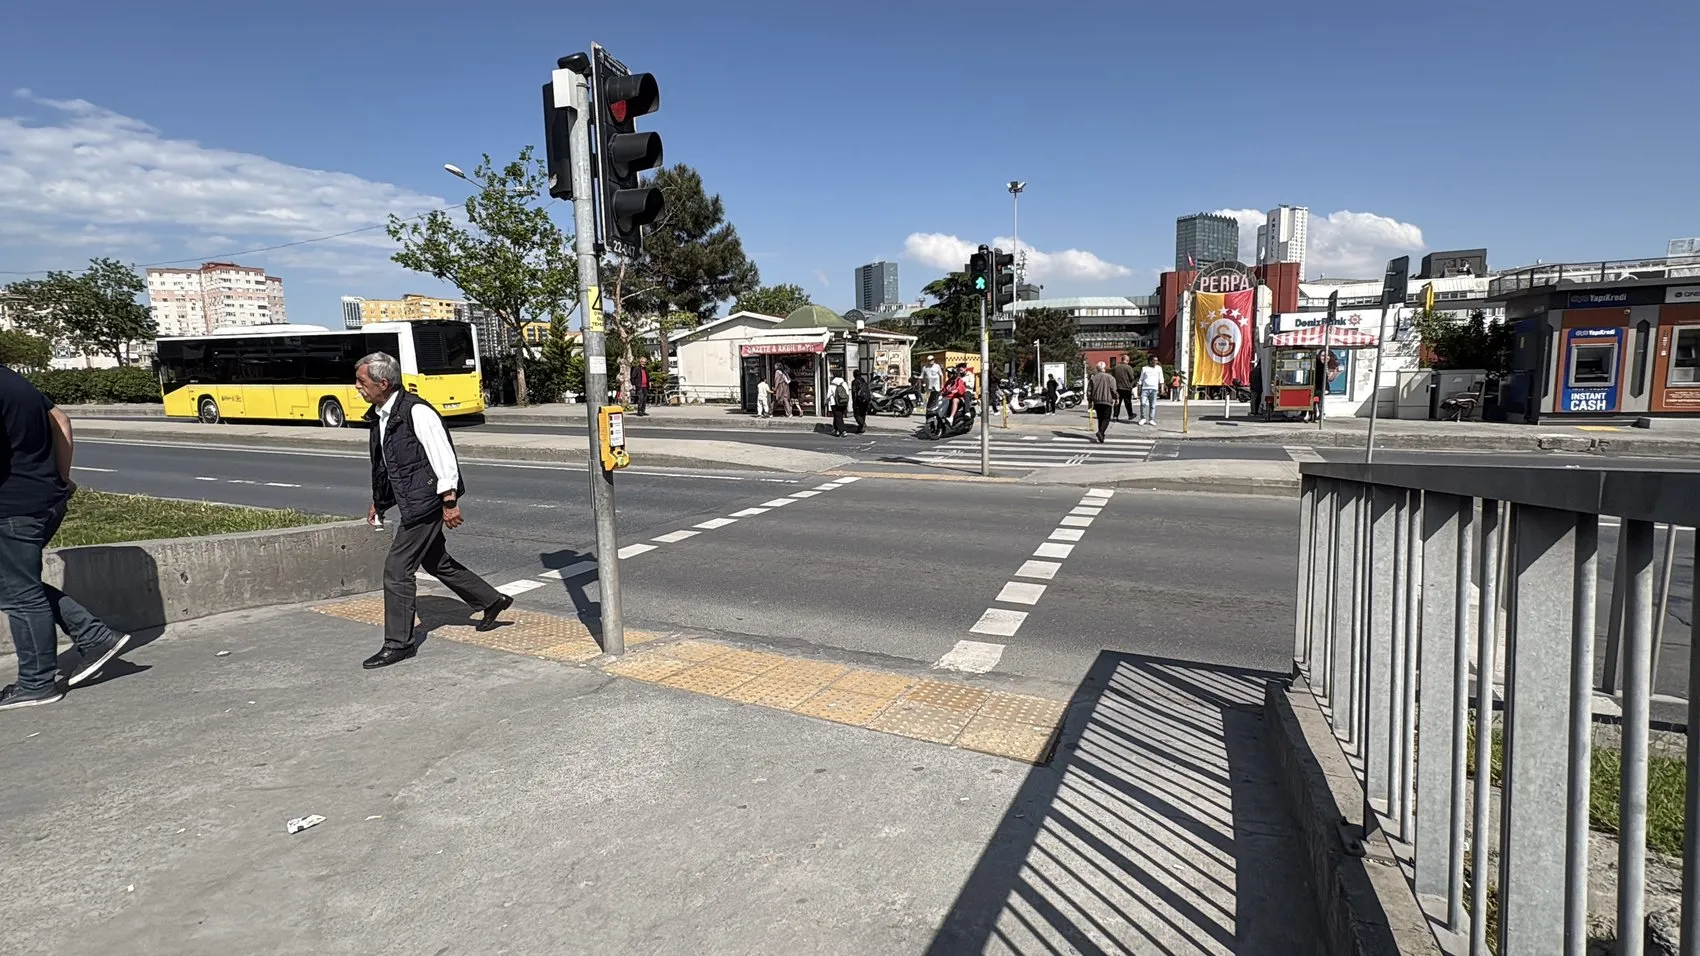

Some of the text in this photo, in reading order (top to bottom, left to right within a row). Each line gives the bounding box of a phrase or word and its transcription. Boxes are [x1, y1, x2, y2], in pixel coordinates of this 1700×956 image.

[1200, 274, 1249, 292] PERPA
[747, 345, 771, 353] GAZETE
[1571, 392, 1606, 400] INSTANT
[1570, 400, 1606, 411] CASH
